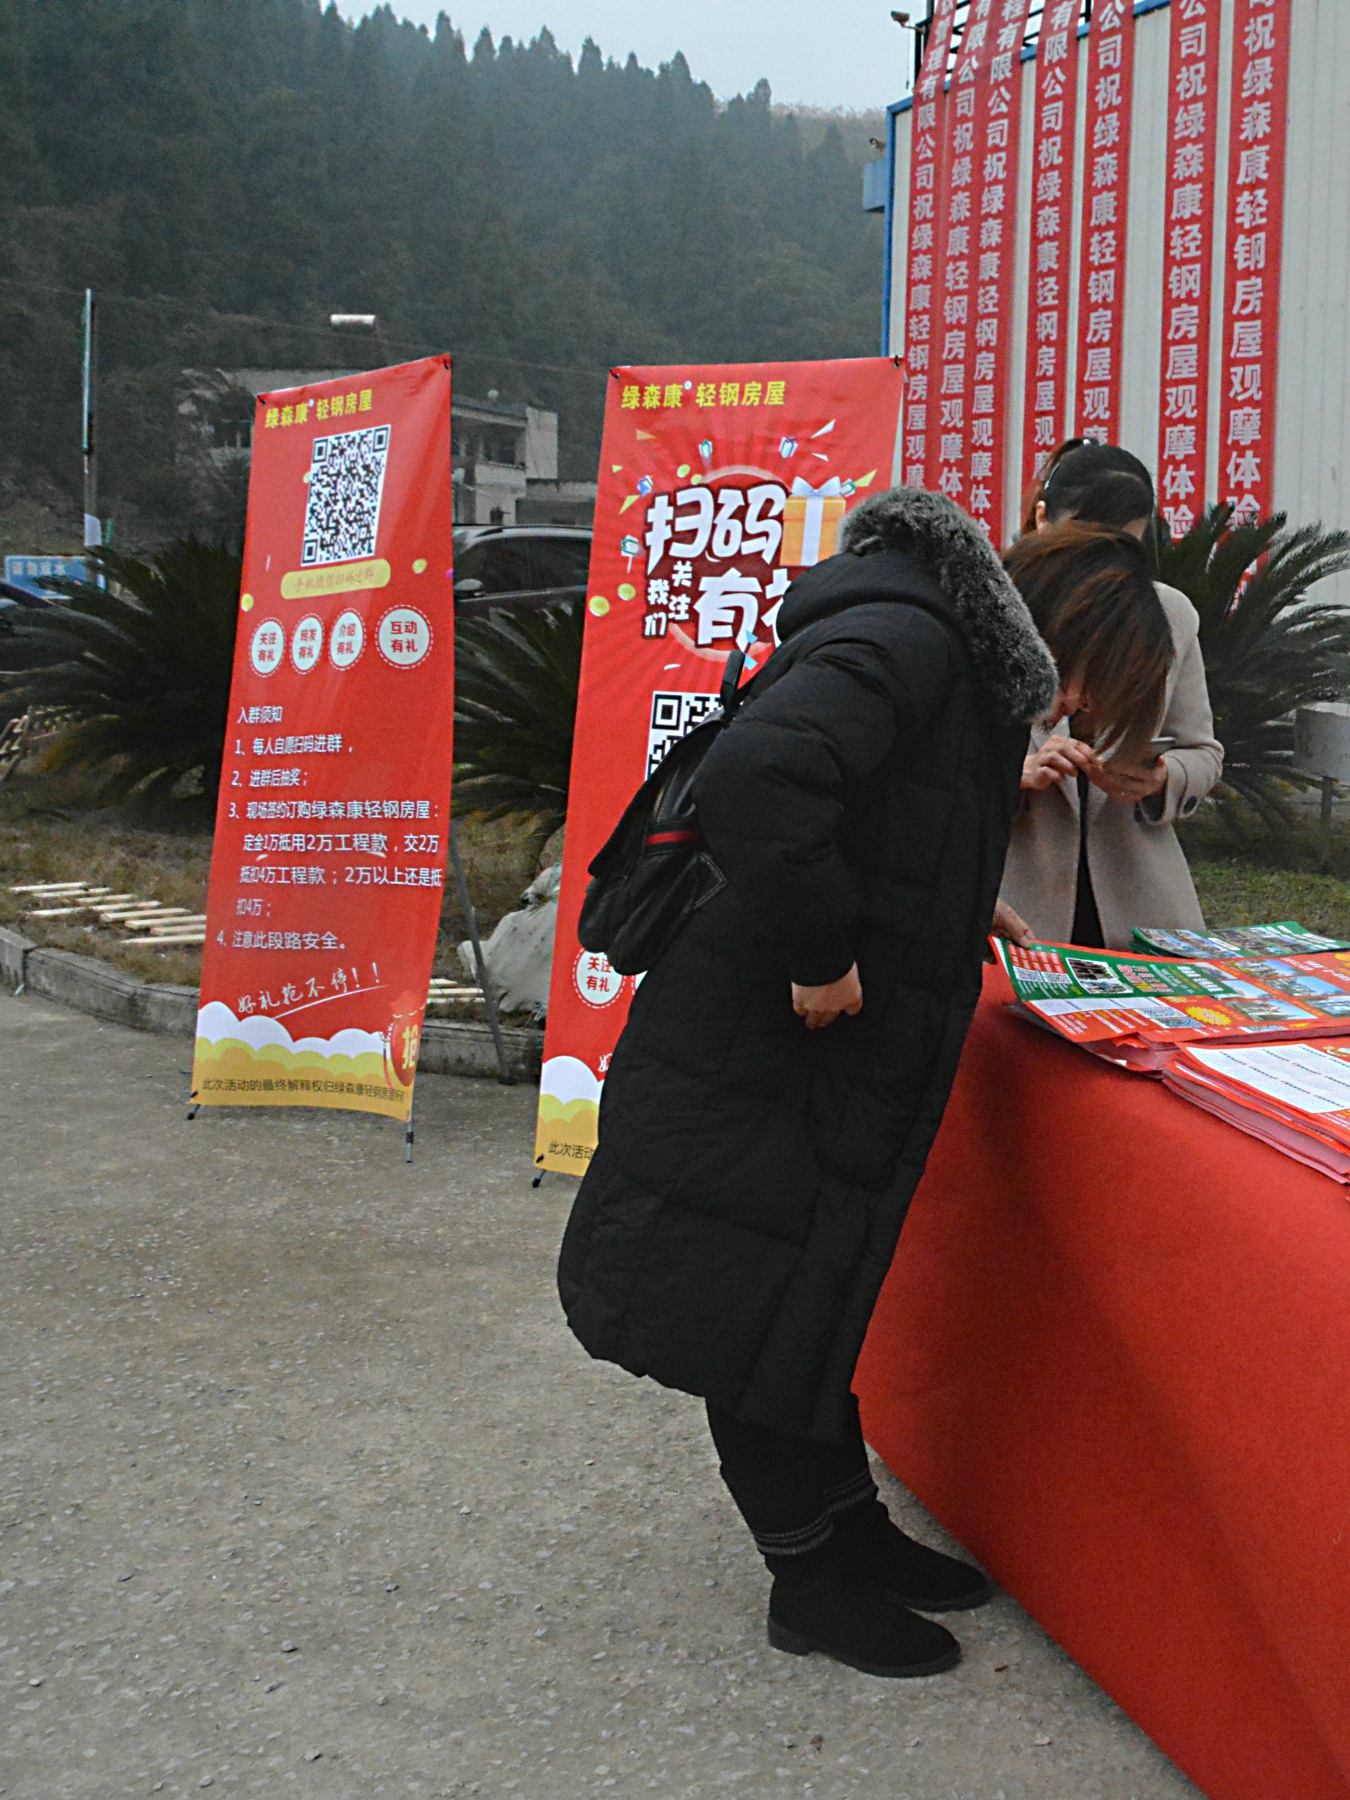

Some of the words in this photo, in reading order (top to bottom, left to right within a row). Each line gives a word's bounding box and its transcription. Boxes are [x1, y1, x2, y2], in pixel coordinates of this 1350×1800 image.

[1226, 0, 1275, 531] 祝绿森康轻钢房屋观摩体验
[696, 381, 786, 407] 轻钢房屋
[645, 483, 789, 575] 扫码
[390, 621, 418, 635] 互动
[390, 639, 418, 653] 有礼
[587, 976, 610, 992] 有礼
